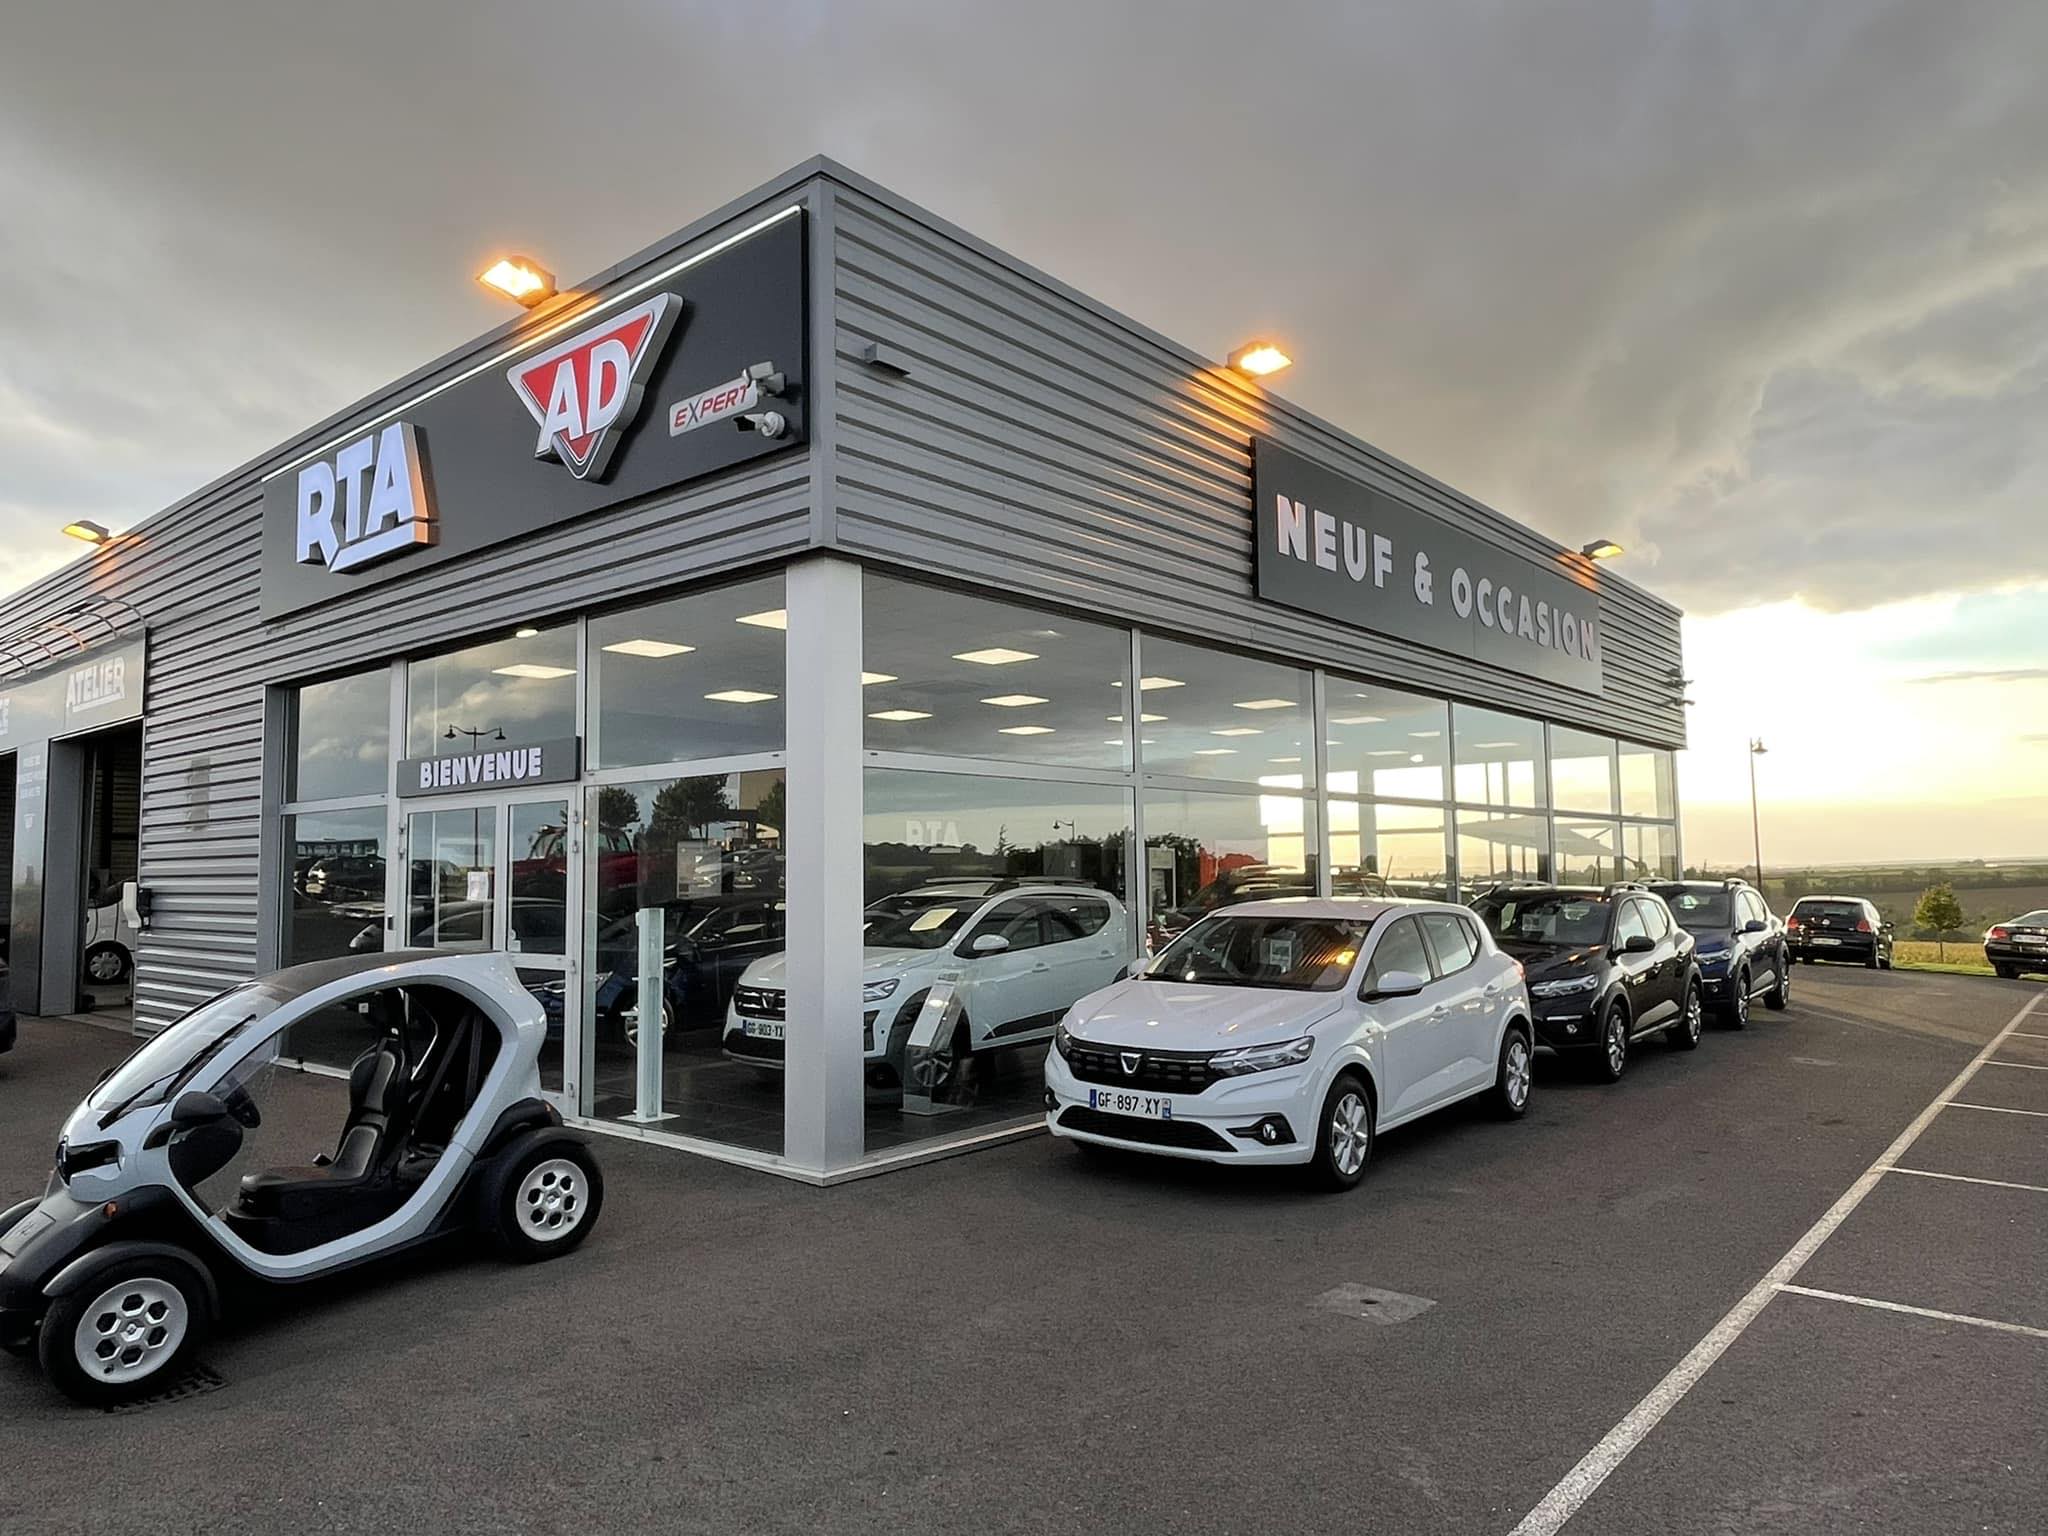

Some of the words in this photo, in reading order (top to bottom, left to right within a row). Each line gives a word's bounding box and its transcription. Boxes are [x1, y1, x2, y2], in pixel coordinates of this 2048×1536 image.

[535, 338, 631, 457] AD
[674, 384, 749, 428] EXPERT
[296, 421, 418, 573] RTA
[1276, 494, 1394, 589] NEUF
[1414, 551, 1434, 606] &
[1451, 567, 1595, 662] OCCASION
[66, 656, 127, 712] ATELIER
[420, 747, 542, 789] BIENVENUE
[1098, 1091, 1161, 1115] GF-897-XY
